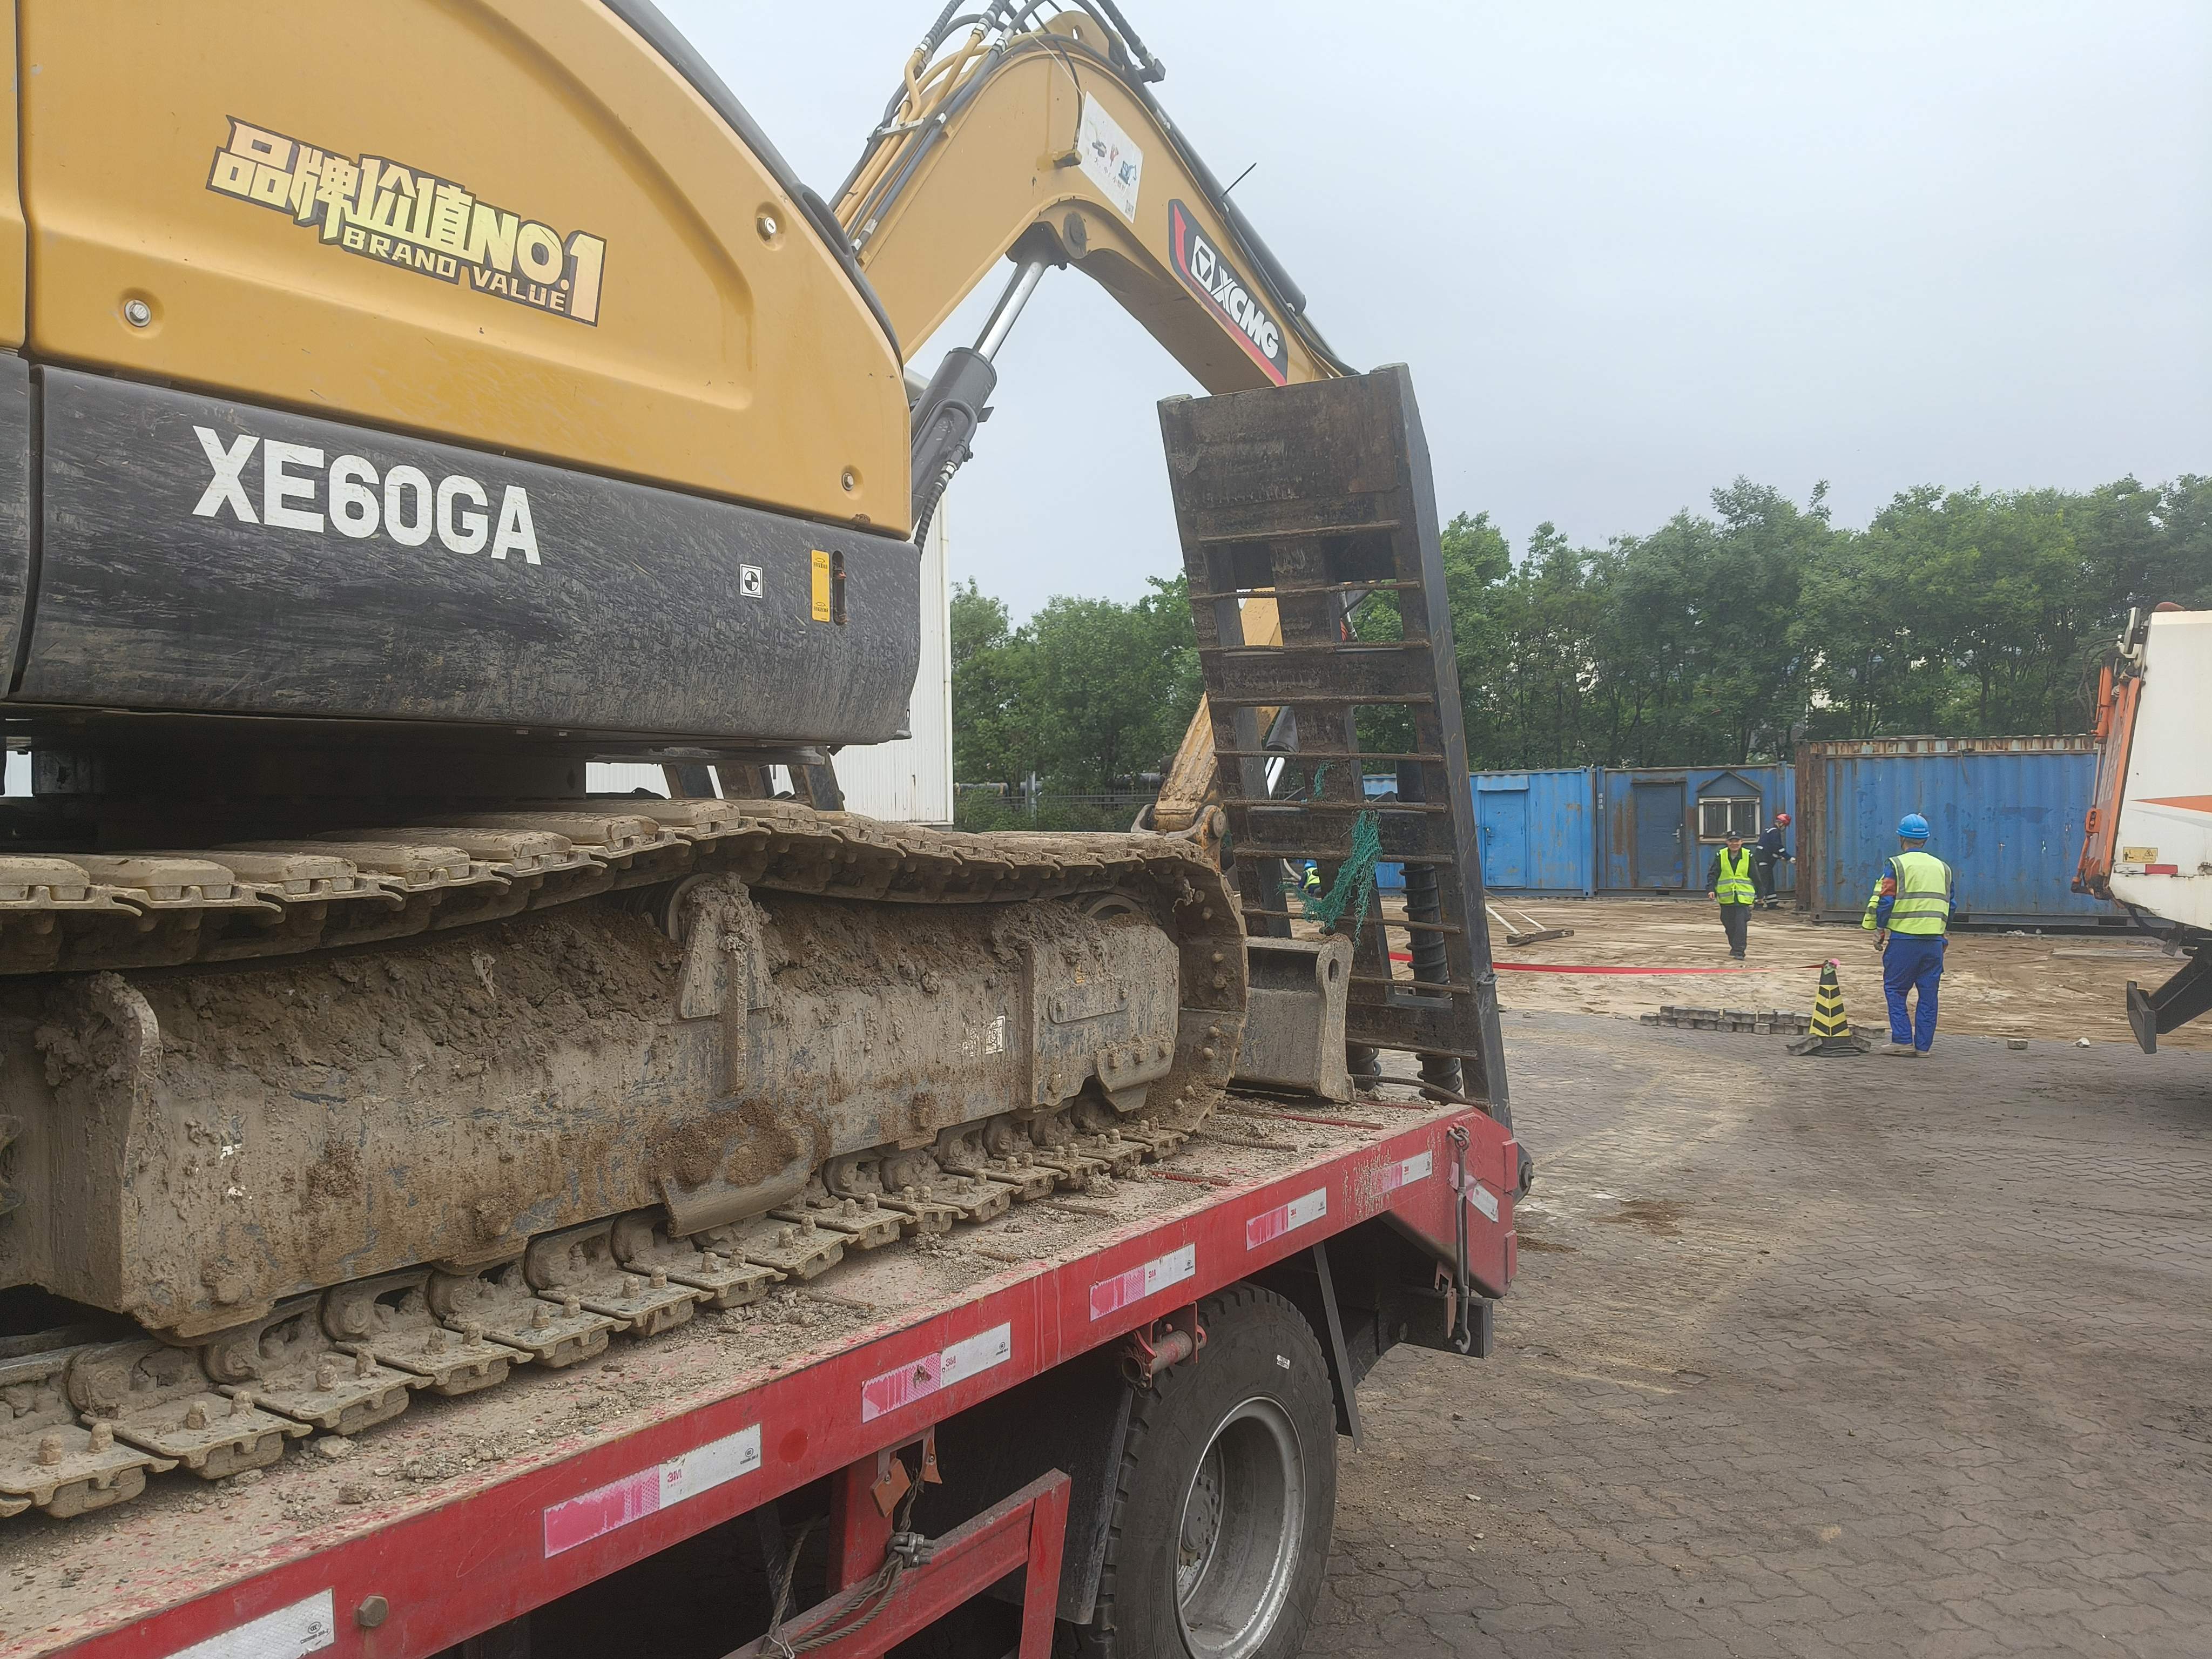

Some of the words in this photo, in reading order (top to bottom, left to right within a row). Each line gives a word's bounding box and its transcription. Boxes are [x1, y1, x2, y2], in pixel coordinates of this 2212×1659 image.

[342, 225, 458, 279] BRAND
[473, 265, 566, 312] VALUE
[1212, 265, 1279, 359] XCMG
[192, 425, 542, 565] XE60GA
[945, 1355, 956, 1367] 3M
[667, 1468, 683, 1483] 3M
